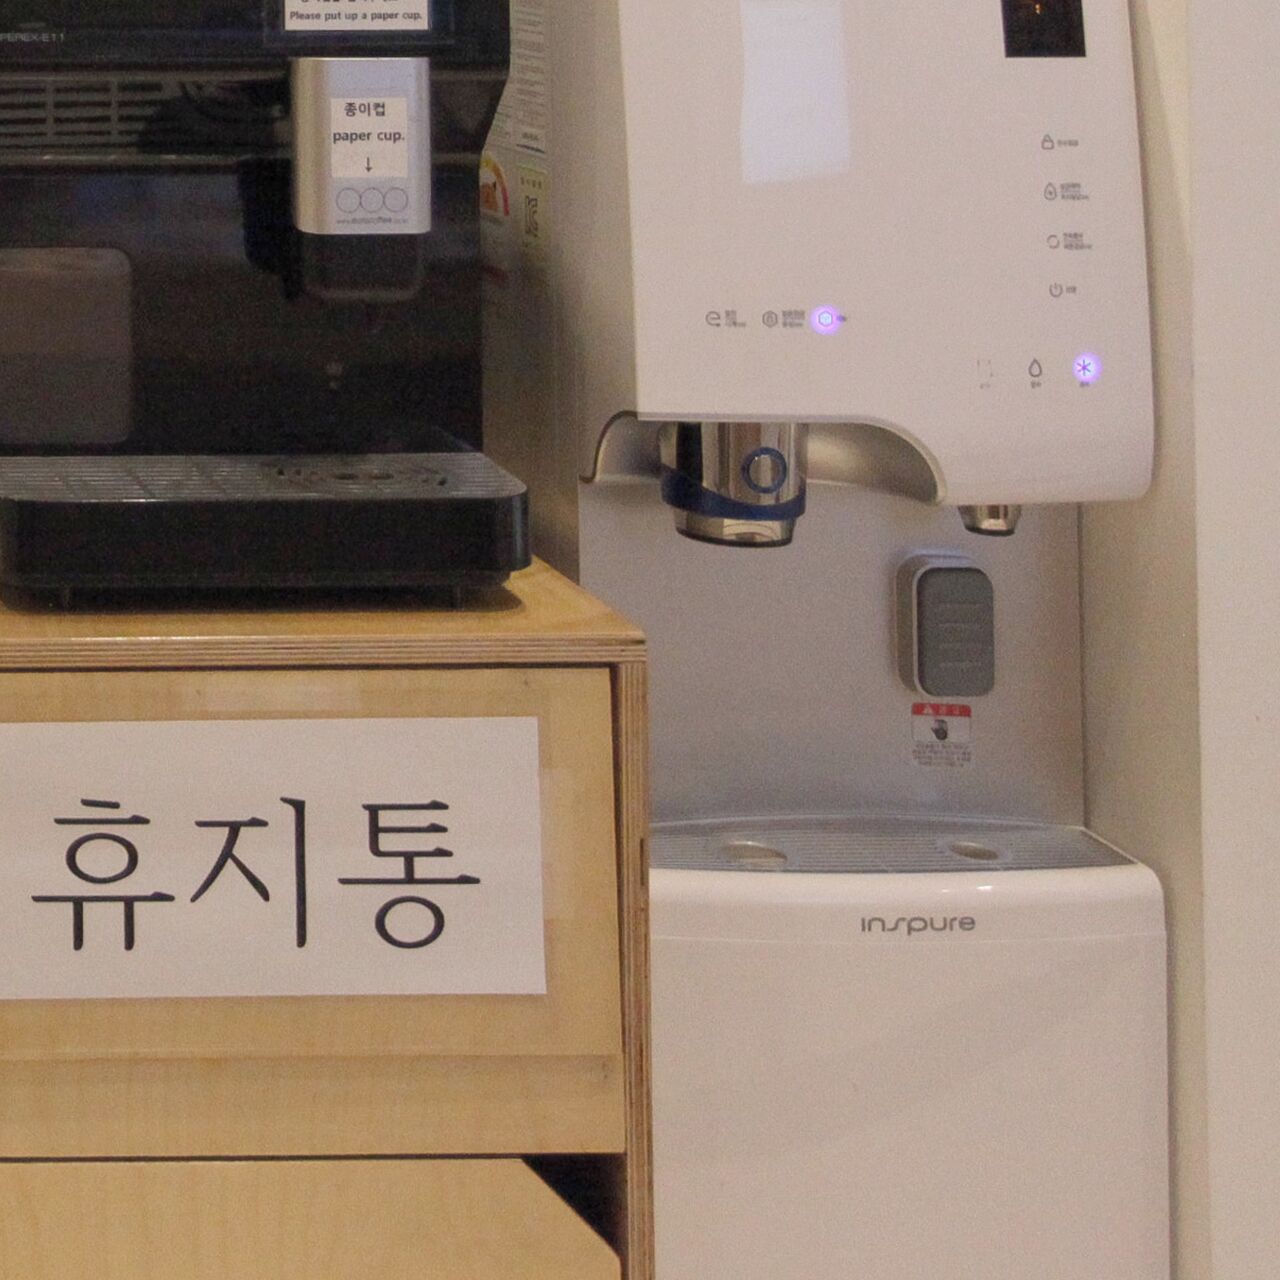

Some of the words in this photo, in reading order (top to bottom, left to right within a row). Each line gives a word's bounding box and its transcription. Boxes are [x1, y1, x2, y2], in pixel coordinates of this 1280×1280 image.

[289, 10, 321, 21] Please
[324, 11, 342, 23] put
[345, 13, 359, 23] up
[361, 13, 368, 21] a
[370, 12, 399, 24] paper
[402, 12, 424, 24] cup.
[343, 102, 387, 118] 종이컵
[332, 130, 373, 145] paper
[376, 130, 406, 145] cup.
[30, 795, 482, 952] 휴지통
[860, 915, 977, 937] inspure
